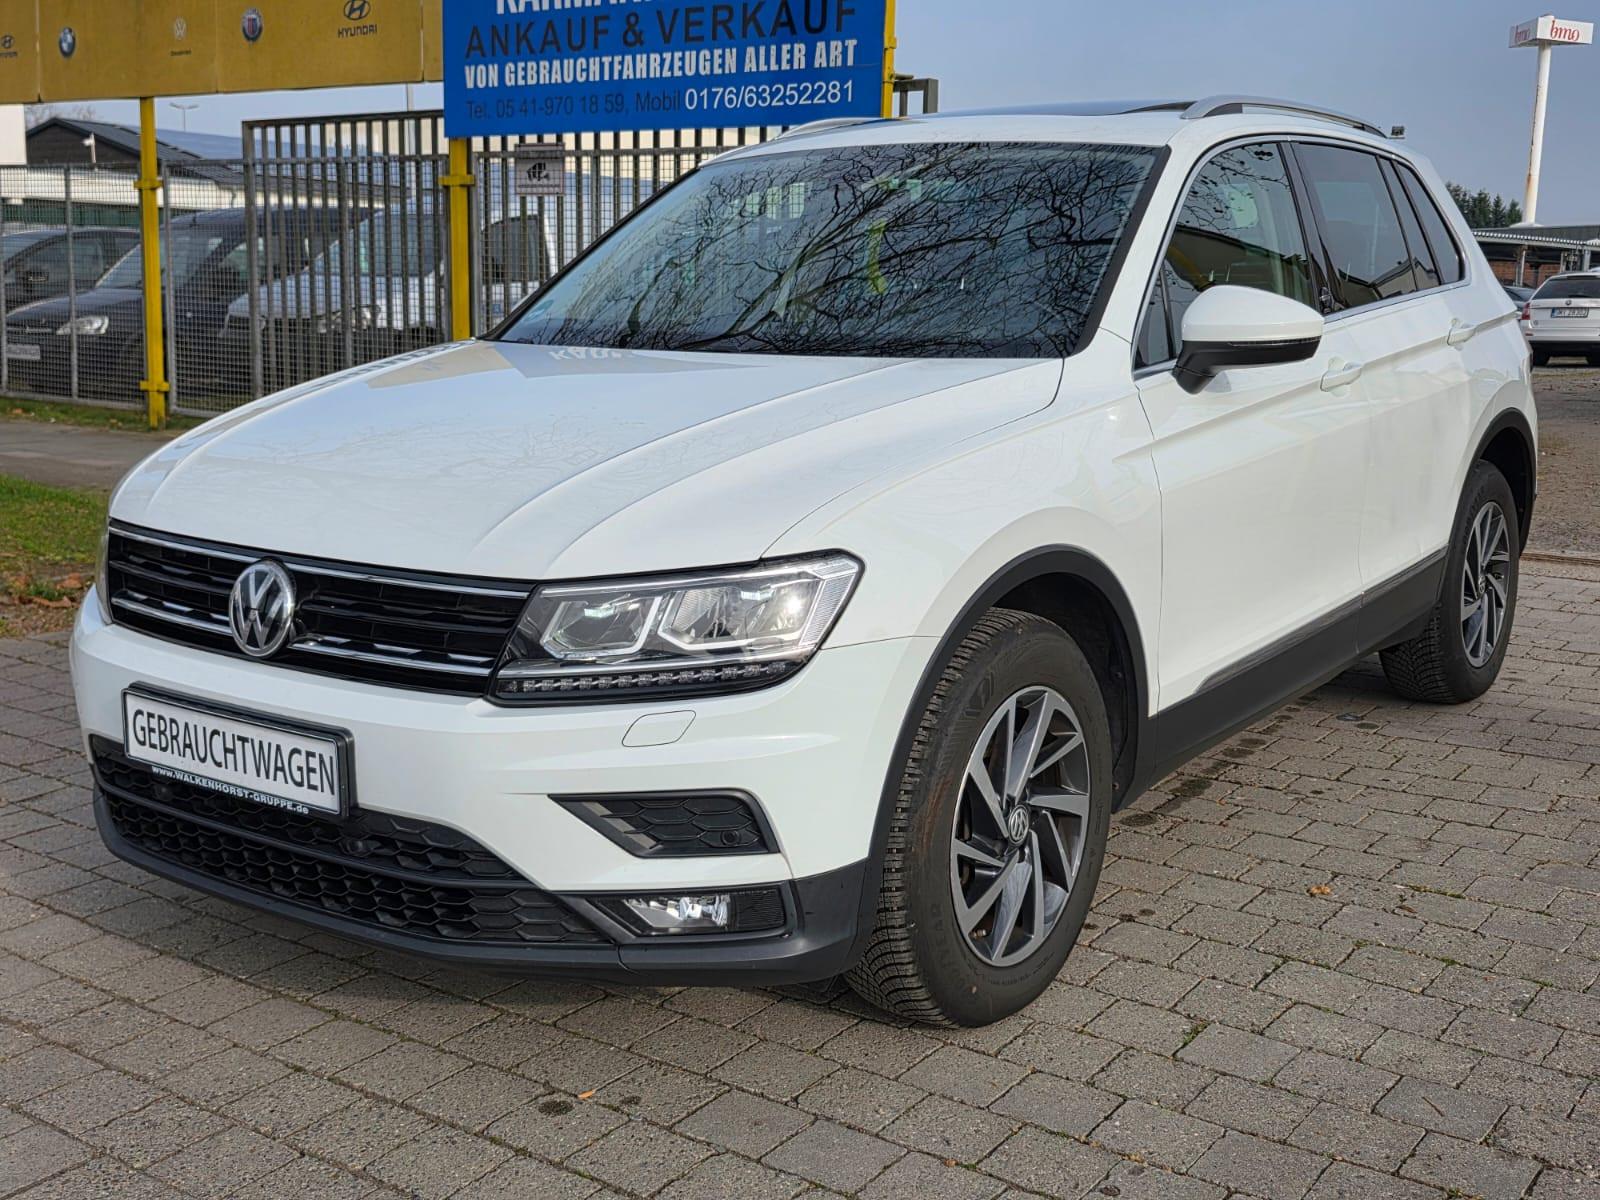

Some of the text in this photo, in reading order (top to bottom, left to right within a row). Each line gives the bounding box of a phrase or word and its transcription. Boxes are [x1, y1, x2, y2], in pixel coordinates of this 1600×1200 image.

[337, 24, 378, 38] HYUNDAI
[465, 0, 855, 59] ANKAUF & VERKAUF
[1550, 20, 1580, 41] bmo
[465, 39, 858, 89] VON GEBRAUCHTFAHRZEUGEN ALLER ART
[466, 100, 489, 119] Tel.
[635, 90, 680, 112] Mobil
[685, 79, 854, 110] 0176/63252281
[132, 708, 336, 796] GEBRAUCHTWAGEN
[151, 765, 309, 814] www.WALKENHORST-GRUPPE.de
